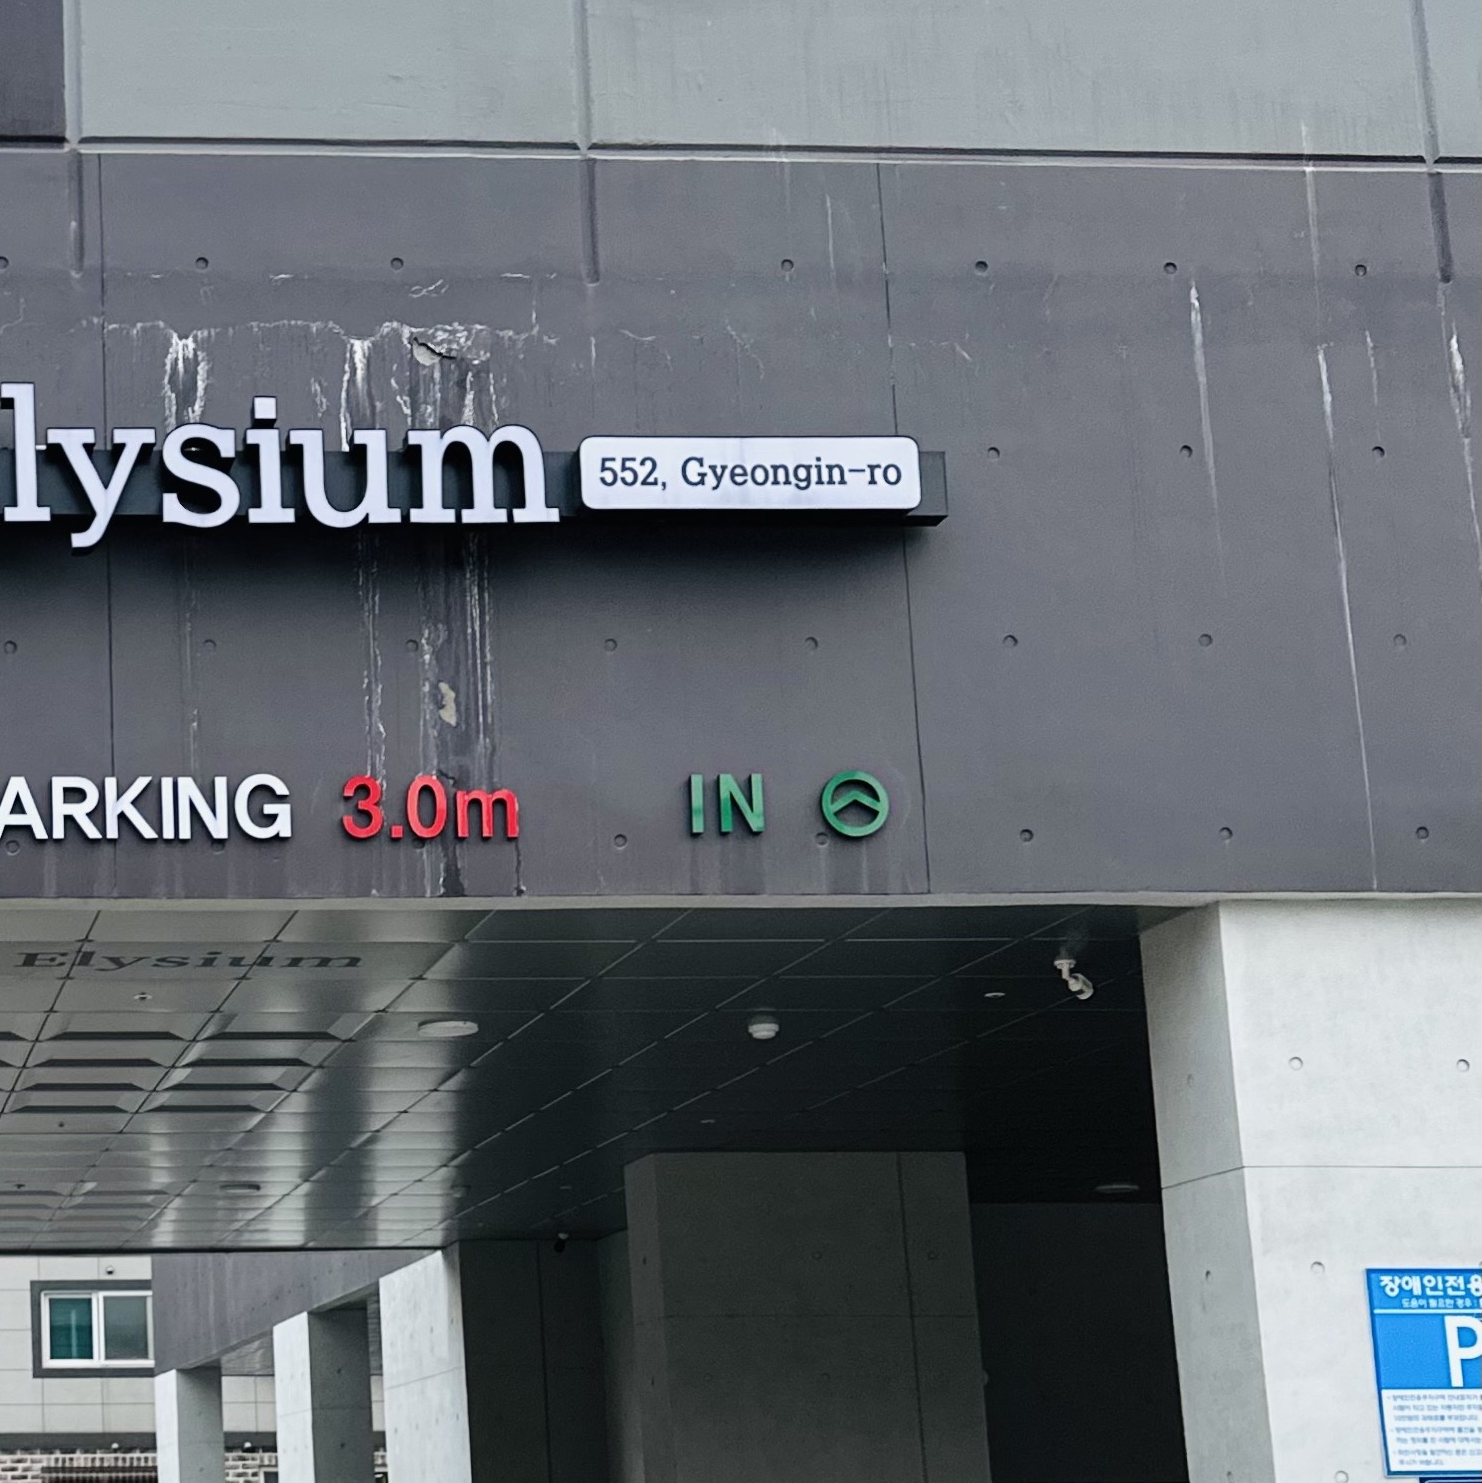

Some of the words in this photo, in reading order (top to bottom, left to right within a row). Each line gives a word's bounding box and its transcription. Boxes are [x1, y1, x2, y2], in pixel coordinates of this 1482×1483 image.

[598, 458, 668, 492] 552,
[680, 456, 902, 494] Gyeongin-ro
[339, 776, 521, 840] 3.0m
[688, 775, 766, 834] IN
[15, 951, 363, 972] Elysium
[1379, 1274, 1482, 1297] 장애인전용
[1443, 1315, 1482, 1387] P
